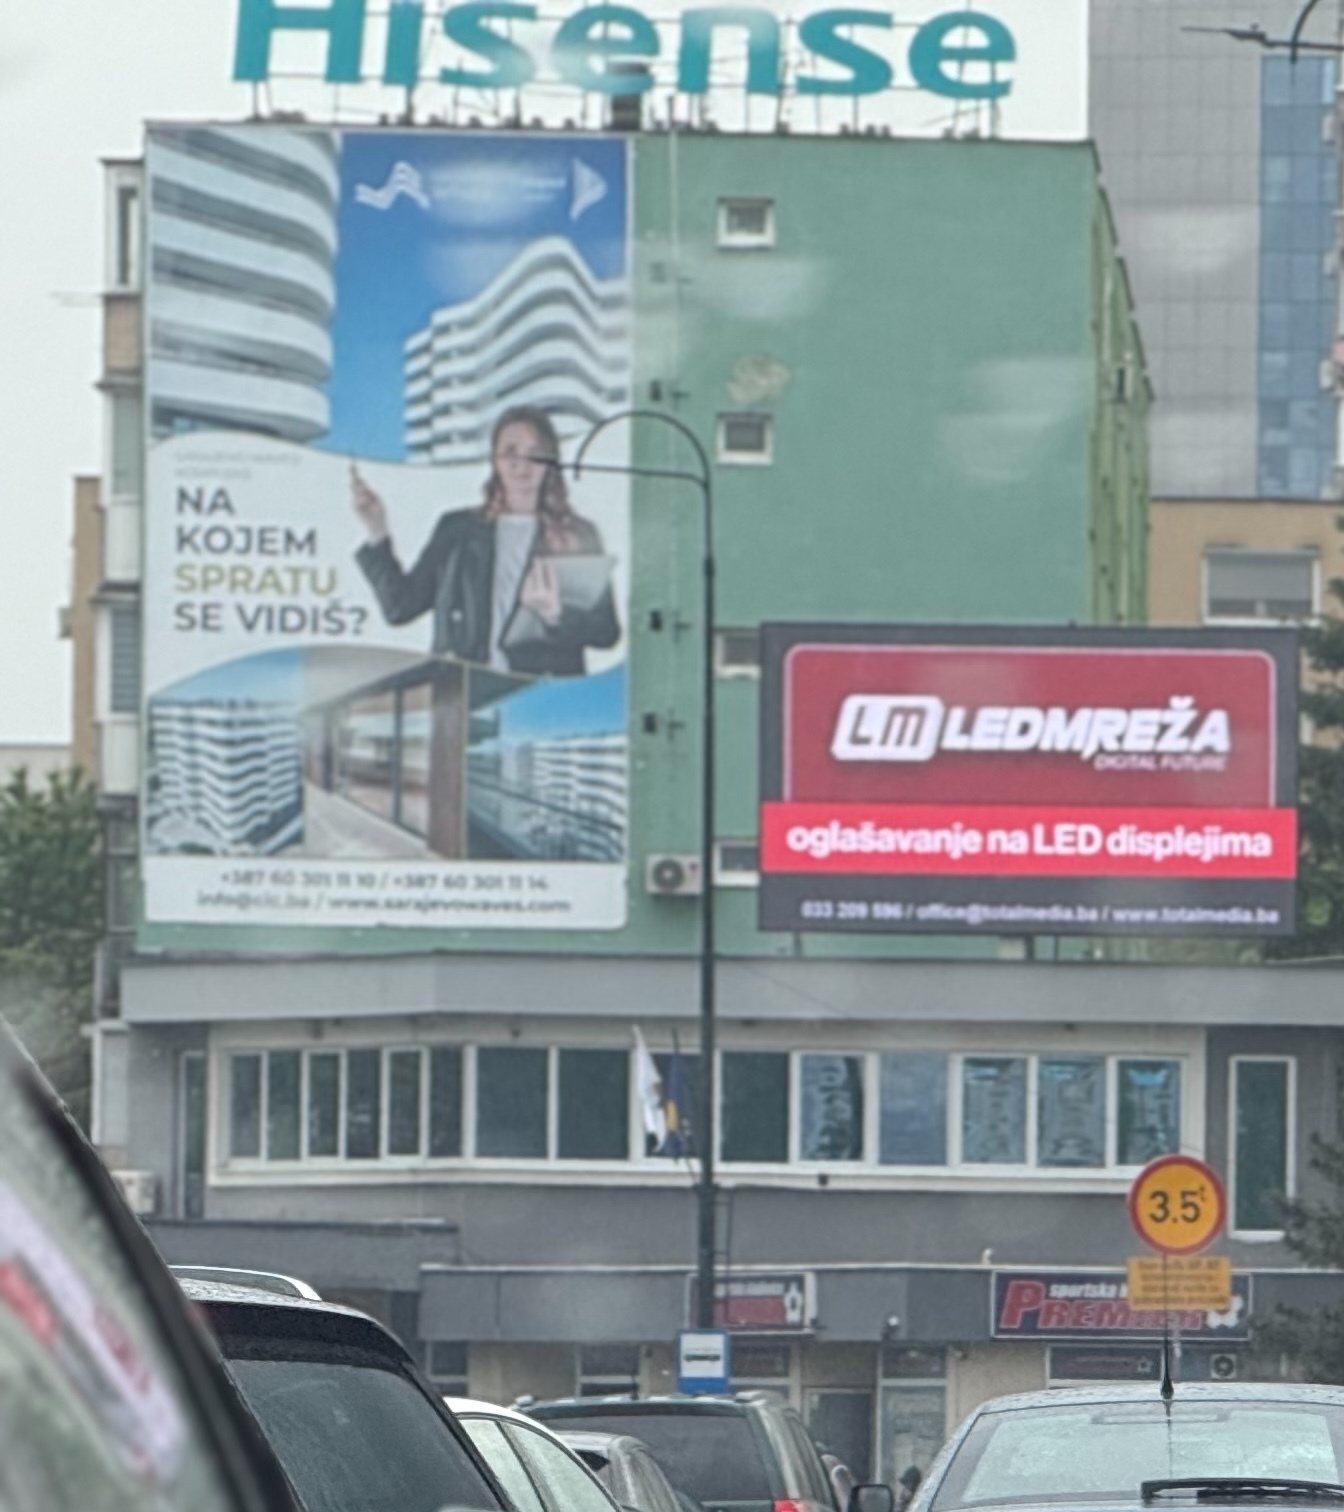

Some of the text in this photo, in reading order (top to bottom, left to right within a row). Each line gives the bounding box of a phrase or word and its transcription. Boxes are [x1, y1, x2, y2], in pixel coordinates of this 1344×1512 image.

[232, 0, 1017, 98] Hisense
[175, 487, 235, 516] NA
[175, 524, 318, 556] KOJEM
[174, 563, 338, 597] SPRATU
[174, 600, 368, 635] SE VIDIŠ?
[941, 696, 1232, 760] LEDMREŽA
[1094, 752, 1157, 771] DIGITAL
[786, 820, 1273, 863] oglašavanje na LED displejima
[1049, 1283, 1117, 1300] sportska
